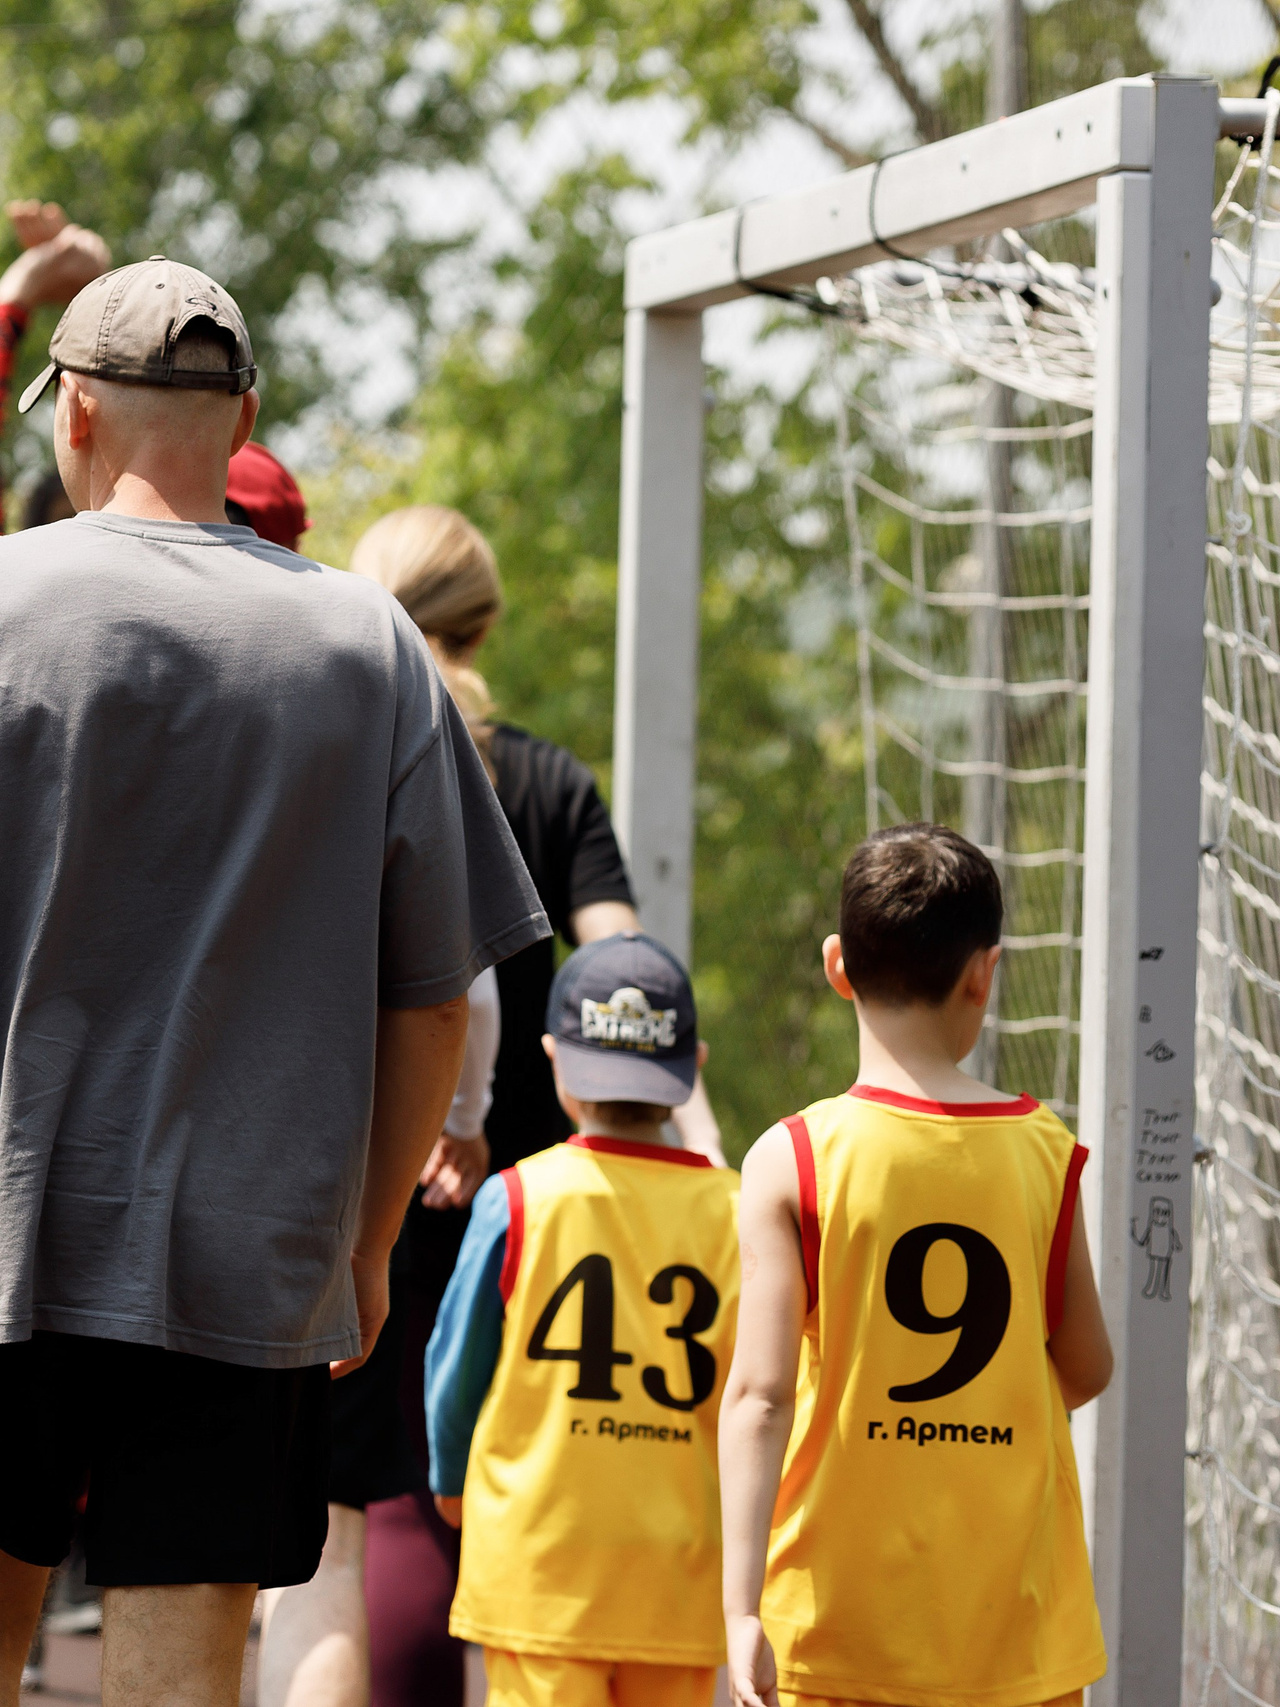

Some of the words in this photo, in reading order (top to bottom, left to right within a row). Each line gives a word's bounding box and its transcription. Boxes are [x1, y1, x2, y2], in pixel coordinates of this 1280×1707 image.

[527, 1253, 720, 1412] 43
[884, 1222, 1012, 1403] 9
[571, 1418, 588, 1435] г.
[597, 1417, 693, 1444] Артем
[867, 1421, 889, 1440] г.
[896, 1416, 1013, 1446] Артем
